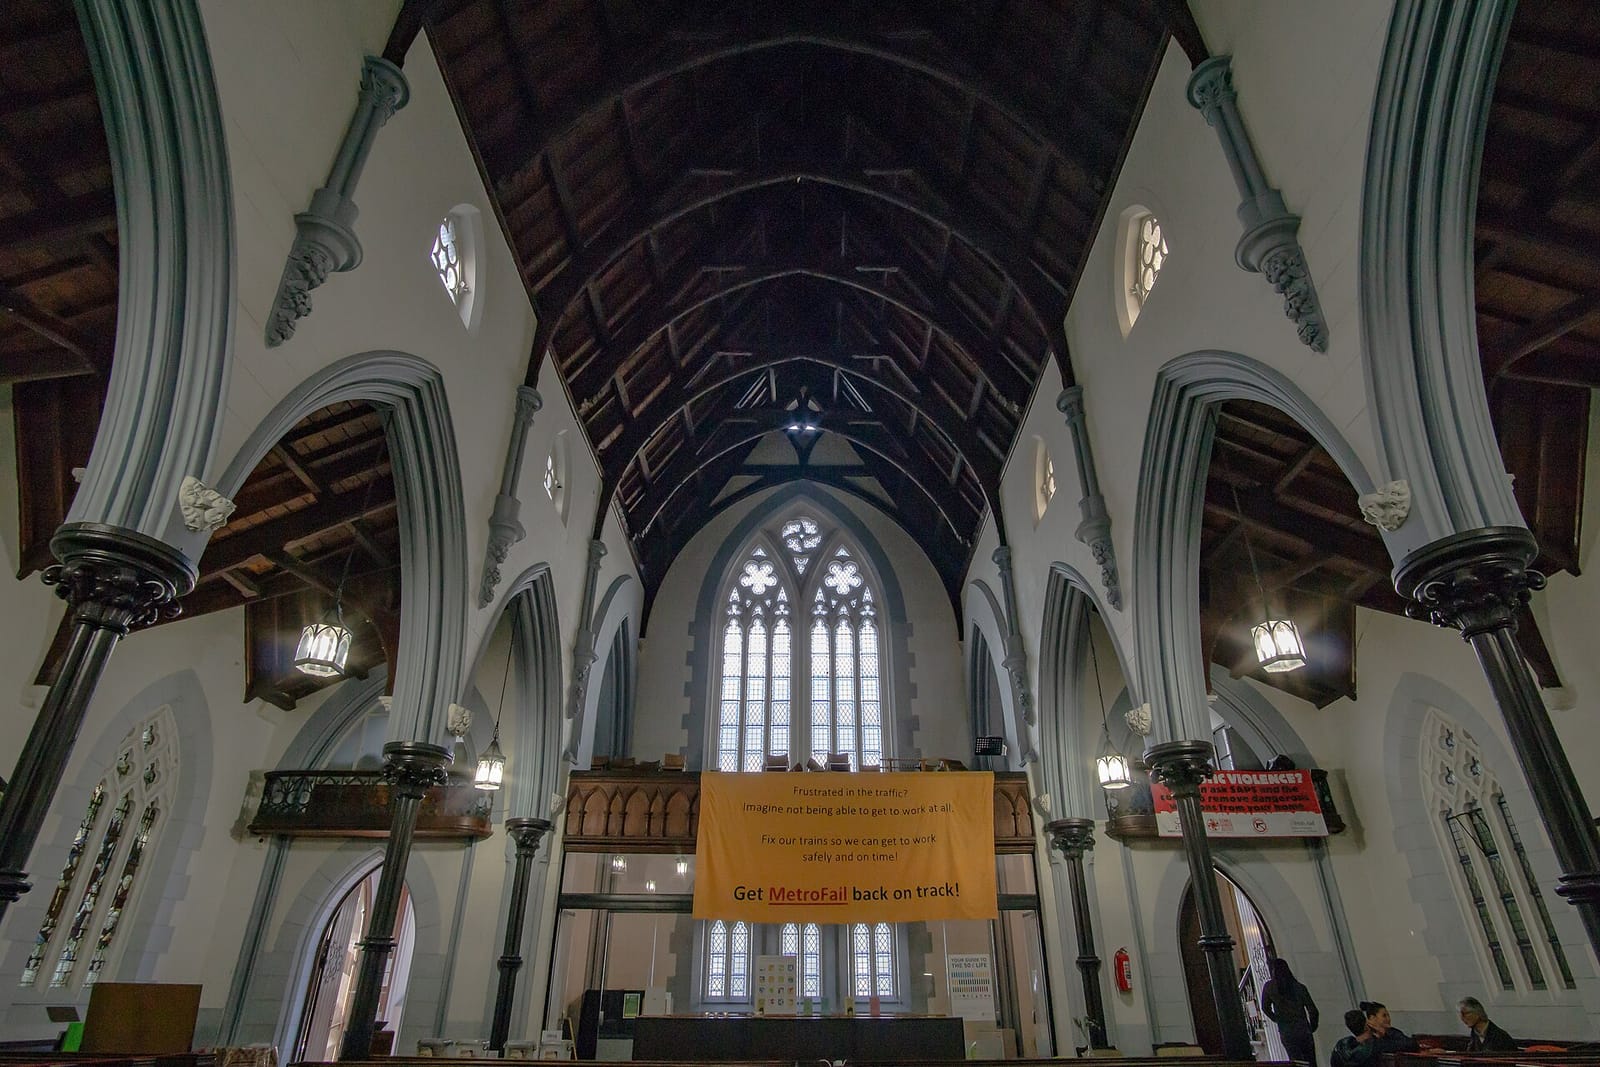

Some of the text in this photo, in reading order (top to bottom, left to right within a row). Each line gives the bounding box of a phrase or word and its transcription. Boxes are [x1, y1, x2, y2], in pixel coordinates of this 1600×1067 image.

[1227, 773, 1303, 784] VIOLENCE?
[794, 786, 907, 797] Frustrated in the traffic?
[1210, 786, 1228, 794] ask
[1231, 786, 1257, 794] SAPS
[1260, 786, 1279, 794] and
[1281, 785, 1298, 793] the
[1208, 795, 1249, 803] remove
[1252, 794, 1310, 804] dangerous
[743, 802, 783, 814] Imagine
[807, 806, 833, 816] being
[836, 806, 856, 815] able
[872, 808, 886, 817] get
[902, 805, 925, 815] work
[1219, 803, 1247, 812] from
[1248, 804, 1272, 813] your
[762, 835, 775, 844] Fix
[779, 837, 796, 845] our
[800, 836, 827, 845] trains
[882, 838, 896, 847] get
[913, 834, 935, 844] work
[803, 851, 897, 863] safely and on time!
[734, 883, 959, 905] Get MetroFail back on track!
